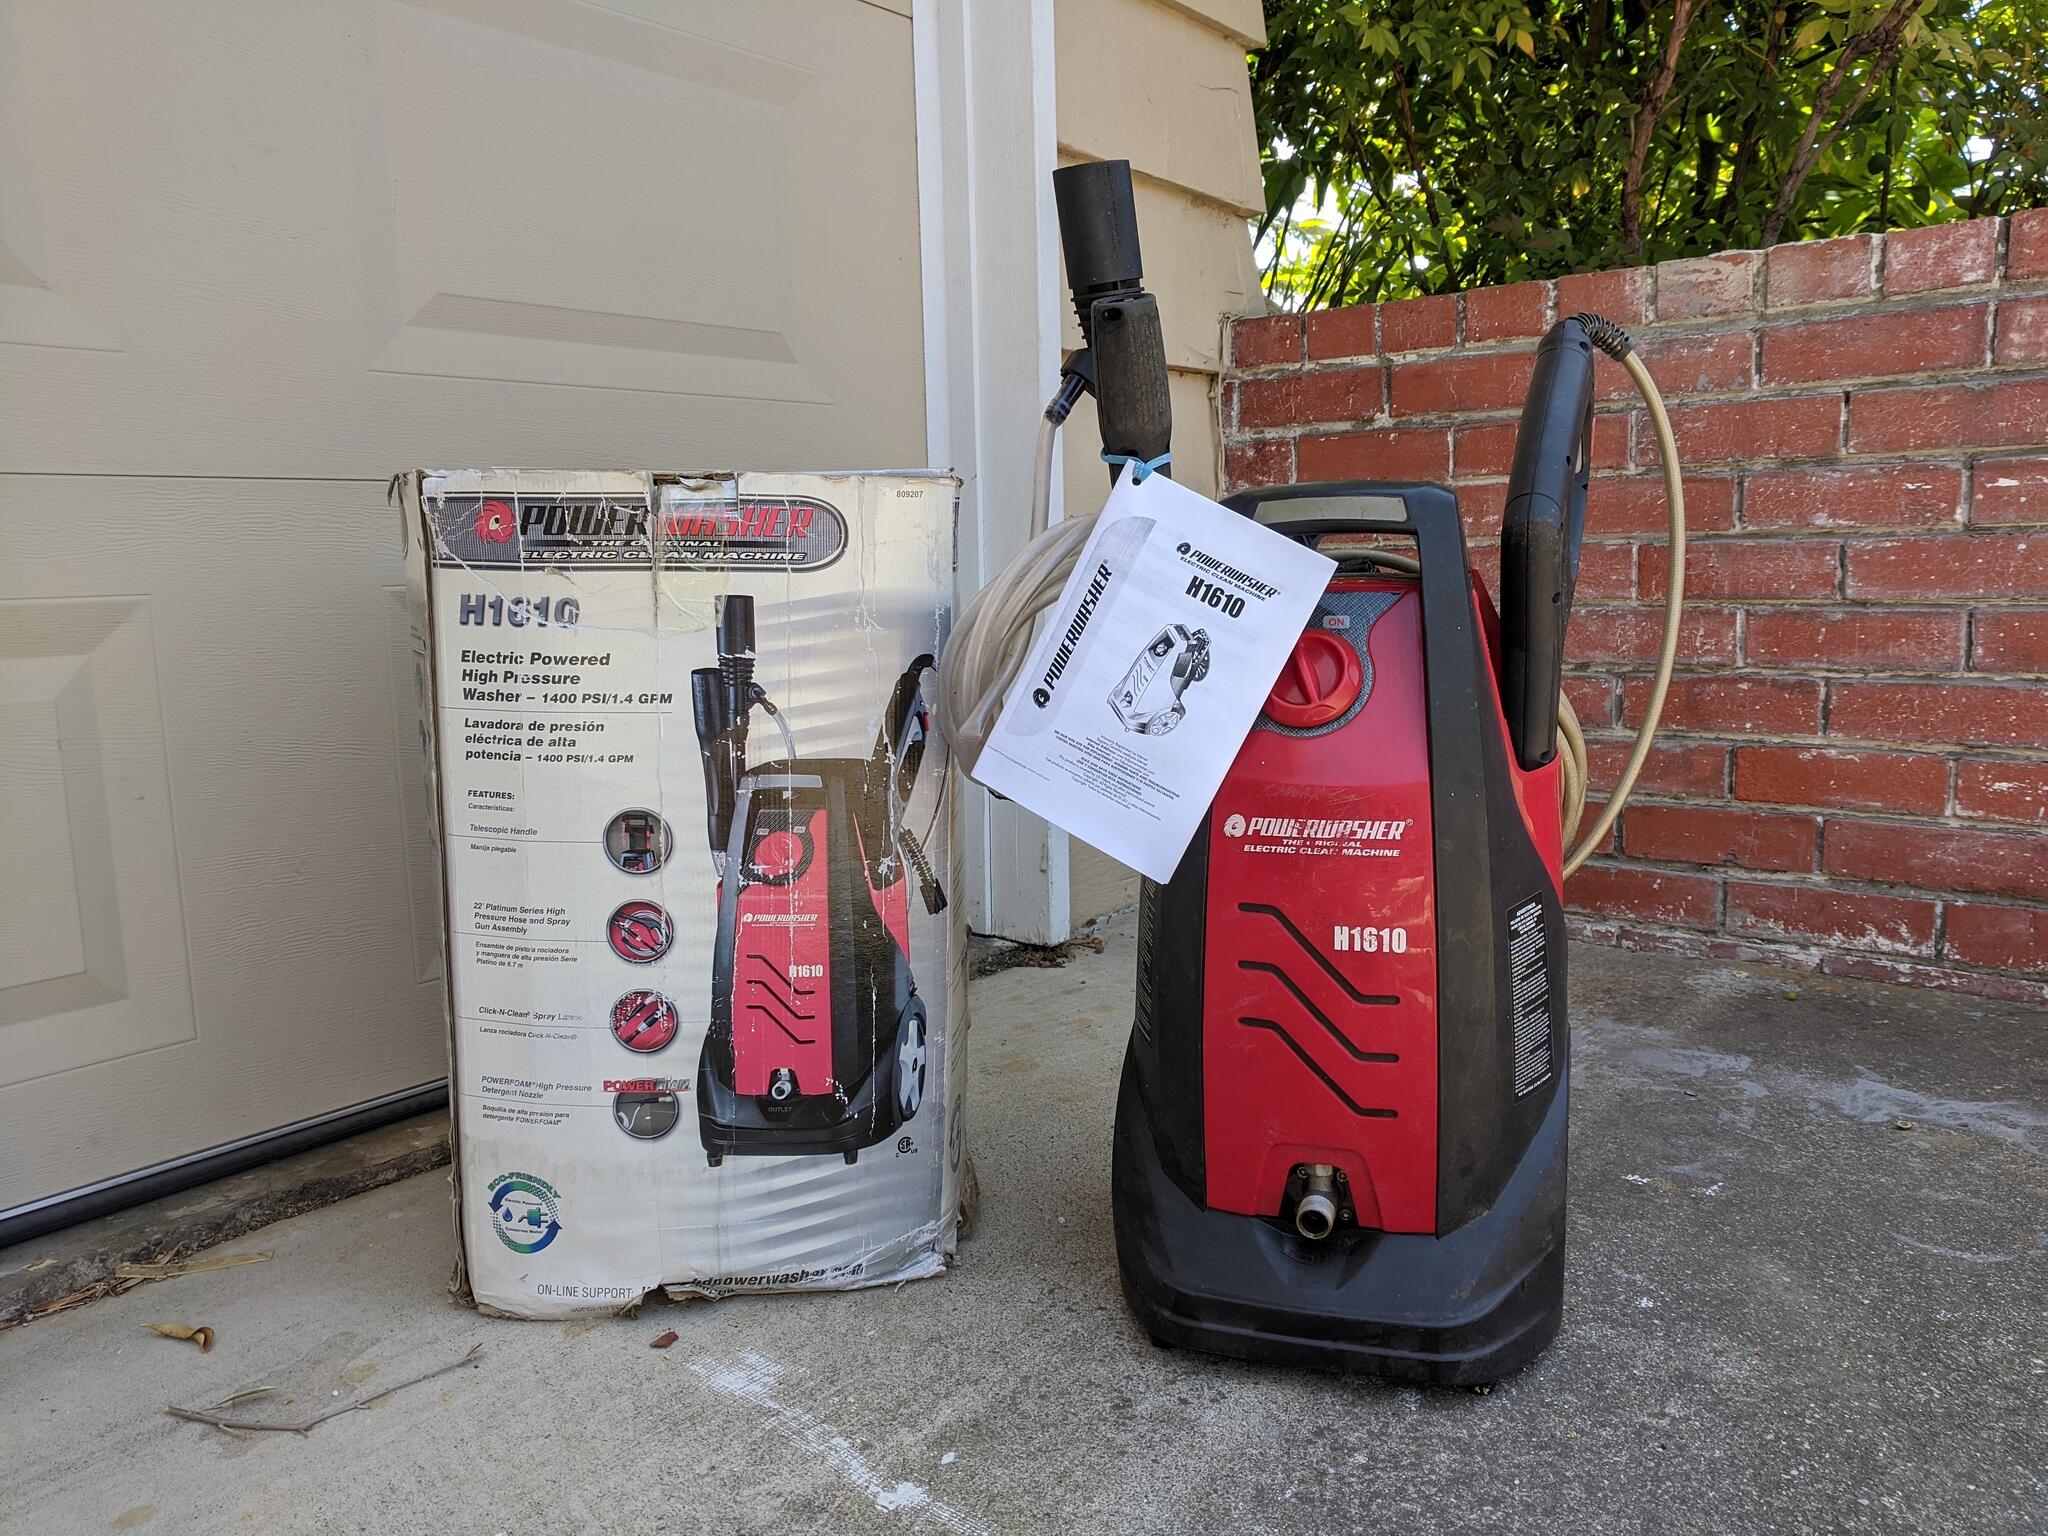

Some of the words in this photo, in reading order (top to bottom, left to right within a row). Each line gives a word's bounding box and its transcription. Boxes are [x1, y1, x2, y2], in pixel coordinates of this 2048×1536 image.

[896, 490, 924, 498] 809207
[519, 504, 814, 538] POWERWASHER
[630, 540, 723, 548] OIGINAL
[519, 550, 617, 560] ELECTRIC
[702, 551, 807, 561] MACHINE
[1180, 556, 1211, 574] ELECTRIC
[1211, 572, 1233, 585] CLEAN
[1233, 583, 1267, 602] MACHINE
[1189, 549, 1278, 598] POWERWASHER
[1185, 575, 1246, 619] H1610
[459, 593, 580, 627] H1610
[1043, 562, 1112, 690] POWERWASHER
[1328, 618, 1345, 626] ON
[461, 649, 524, 665] Electric
[530, 652, 611, 666] Powered
[462, 669, 498, 685] High
[503, 670, 581, 685] Pressure
[463, 687, 522, 703] Washer
[542, 693, 577, 704] 1400
[581, 693, 633, 705] PSI/1.4
[638, 693, 673, 704] GPM
[464, 717, 524, 731] Lavadora
[528, 720, 546, 732] de
[549, 720, 605, 734] presión
[464, 735, 522, 746] eléctrica
[527, 736, 544, 747] de
[548, 737, 577, 748] alta
[465, 749, 522, 762] potencia
[537, 754, 563, 763] 1400
[566, 754, 605, 763] PSI/1.4
[608, 755, 634, 763] GPM
[467, 789, 515, 800] FEATURES:
[470, 823, 509, 834] Telescopic
[510, 827, 538, 836] Handle
[1247, 817, 1406, 840] POWERWASHER
[470, 843, 490, 852] Manija
[490, 845, 517, 853] plegable
[1282, 838, 1303, 846] THE
[1244, 844, 1296, 854] ELECTRIC
[1342, 848, 1400, 857] MACHINE
[485, 903, 518, 913] Platinum
[519, 906, 544, 915] Series
[546, 907, 566, 916] High
[474, 912, 507, 922] Pressure
[508, 915, 528, 924] Hose
[546, 917, 571, 927] Spray
[474, 922, 490, 930] Gun
[491, 924, 528, 935] Assembly
[475, 941, 505, 950] Ensamble
[1334, 926, 1407, 954] H1610
[476, 957, 498, 966] Platino
[481, 951, 511, 959] manguera
[532, 955, 559, 963] presión
[560, 955, 578, 963] Serie
[533, 1012, 556, 1021] Spray
[479, 1026, 497, 1034] Lanza
[498, 1029, 527, 1037] rociadora
[481, 1086, 517, 1096] Detergent
[518, 1090, 543, 1099] Nozzle
[535, 1082, 554, 1091] High
[555, 1083, 592, 1091] Pressure
[487, 1172, 562, 1199] ECO-FRIENDLY
[537, 1284, 580, 1297] ON-LINE
[582, 1286, 634, 1299] SUPPORT:
